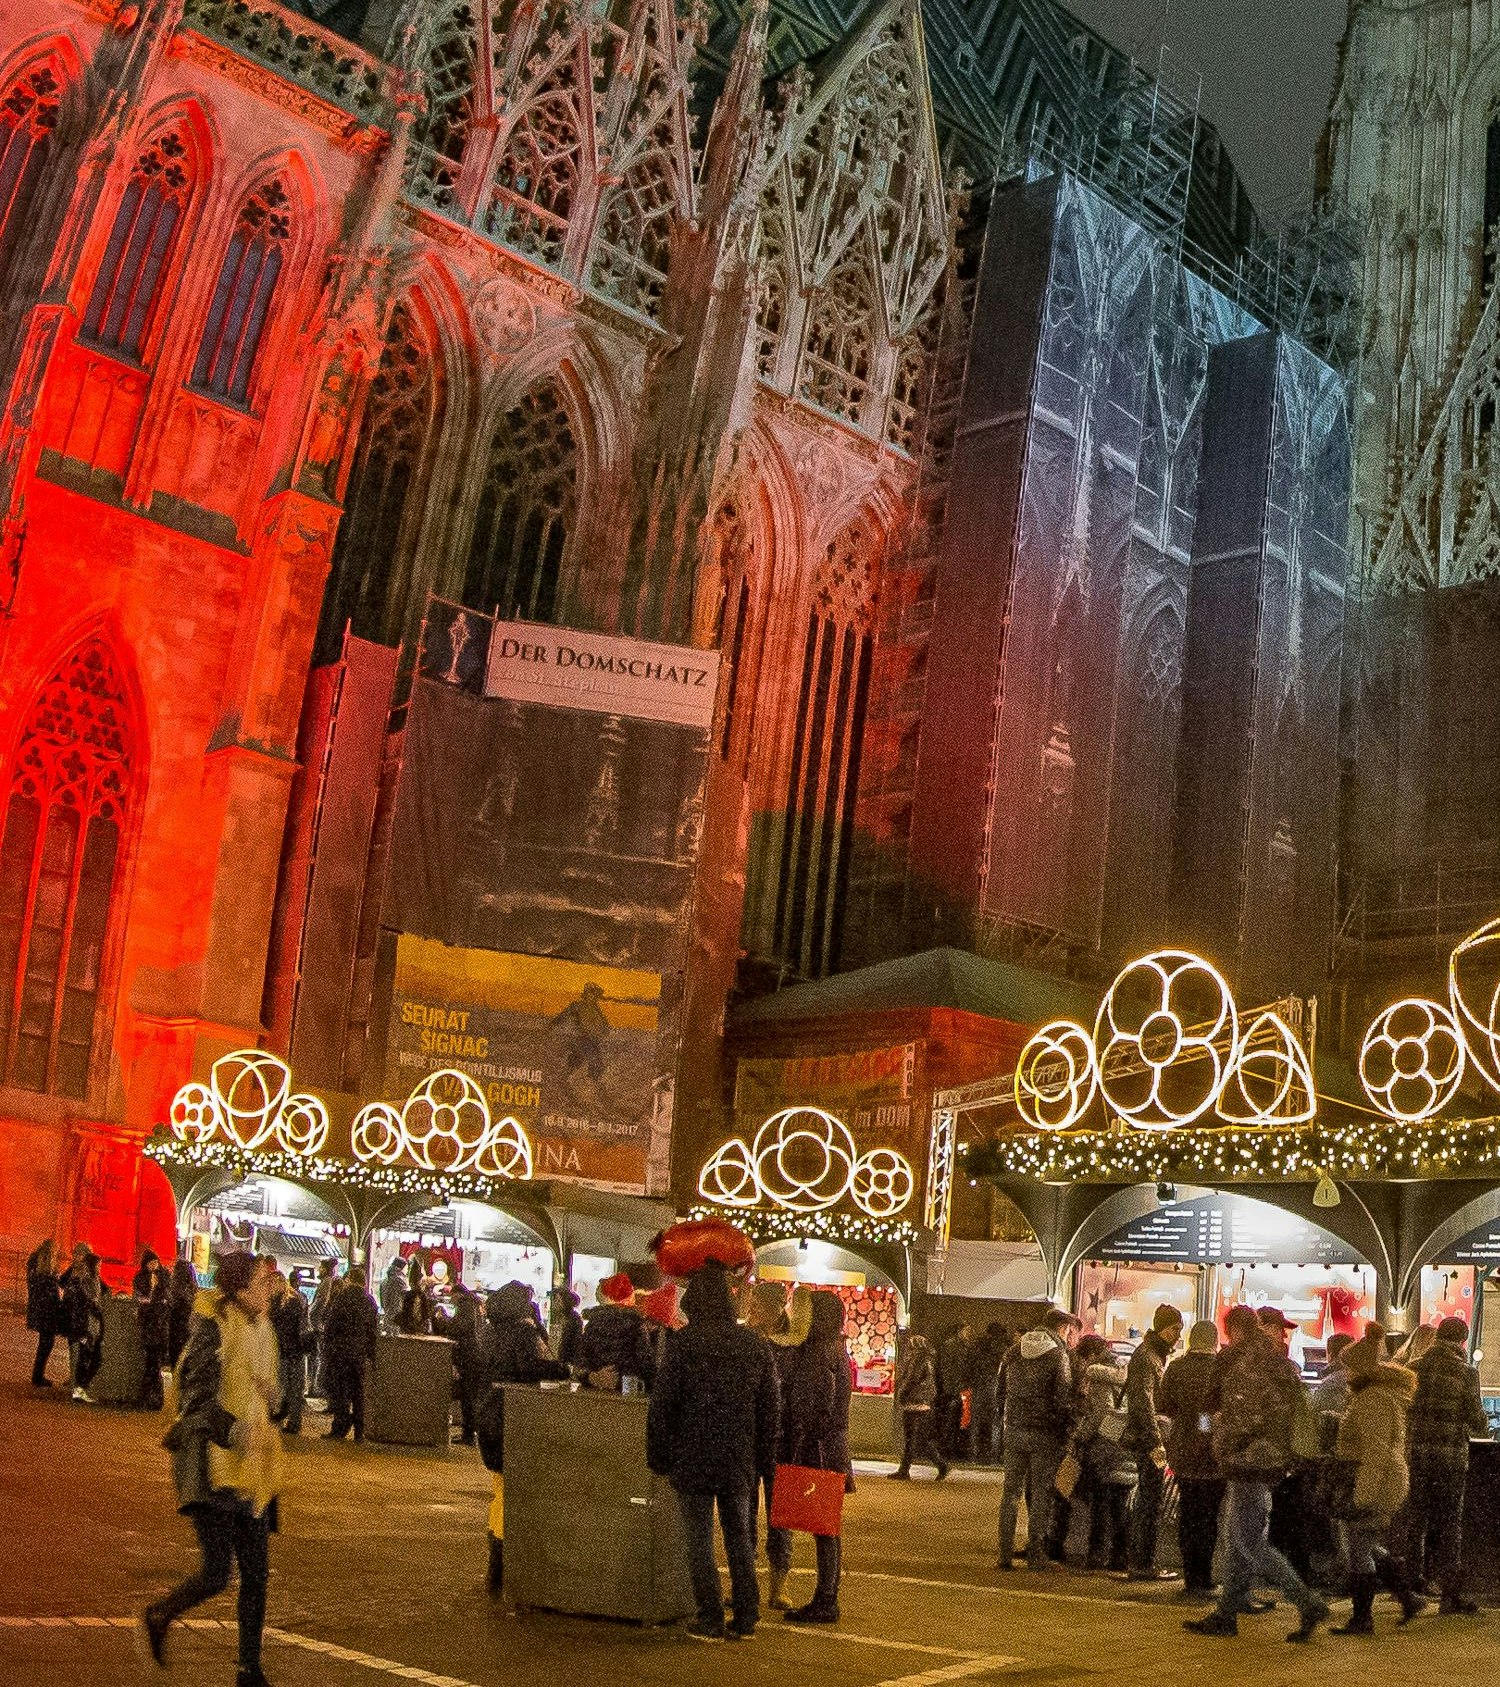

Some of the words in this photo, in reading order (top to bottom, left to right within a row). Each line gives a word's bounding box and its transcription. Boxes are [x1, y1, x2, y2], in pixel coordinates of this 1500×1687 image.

[500, 638, 547, 663] DER
[556, 646, 708, 687] DOMSCHATZ
[401, 1001, 470, 1032] SEURAT
[420, 1028, 489, 1059] SIGNAC
[443, 1077, 481, 1101] VA
[487, 1082, 542, 1108] GOGH
[876, 1104, 911, 1128] DOM
